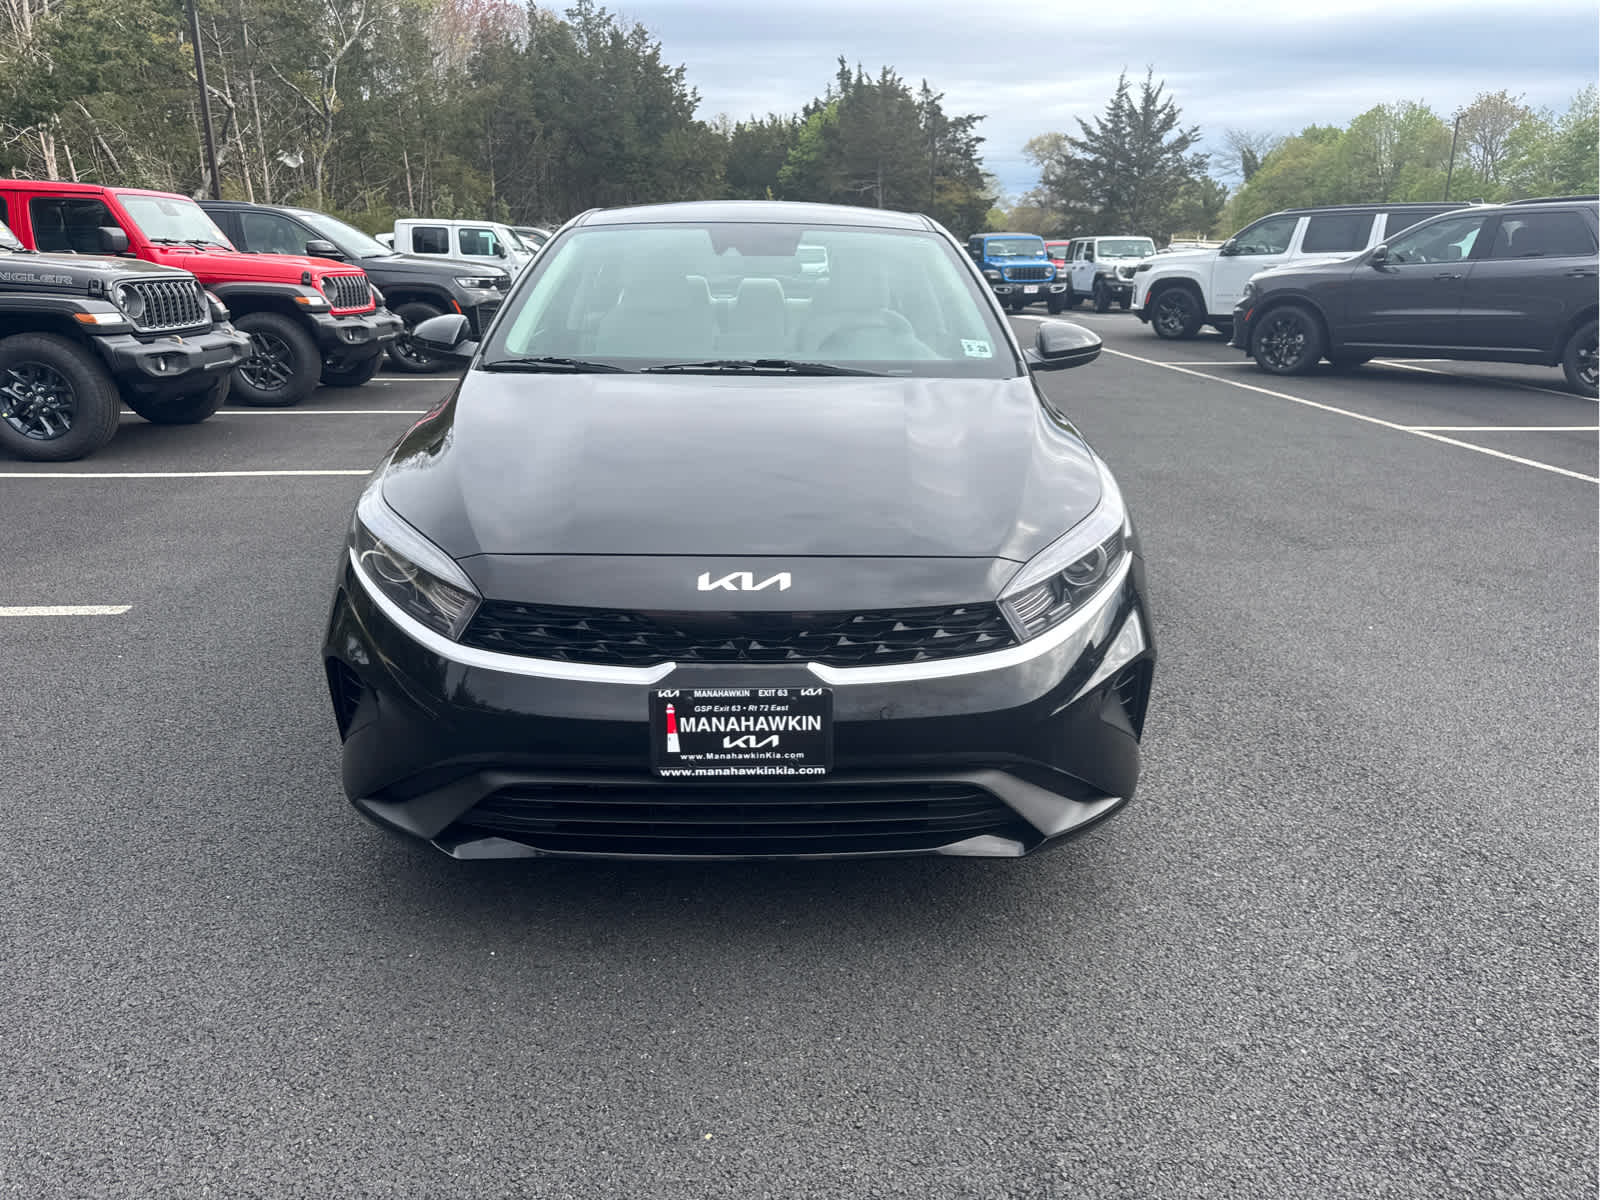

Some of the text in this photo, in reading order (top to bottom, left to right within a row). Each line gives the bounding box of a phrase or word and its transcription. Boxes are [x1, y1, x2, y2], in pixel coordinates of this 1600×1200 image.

[693, 689, 788, 698] MANAHAWKIN EXIT 63
[694, 704, 789, 713] GSP Exit 63 Rt 72 East
[680, 715, 821, 733] MANAHAWKIN
[680, 752, 805, 760] www.ManahawkinKia.com
[660, 765, 826, 777] www.manahawkinkia.com
